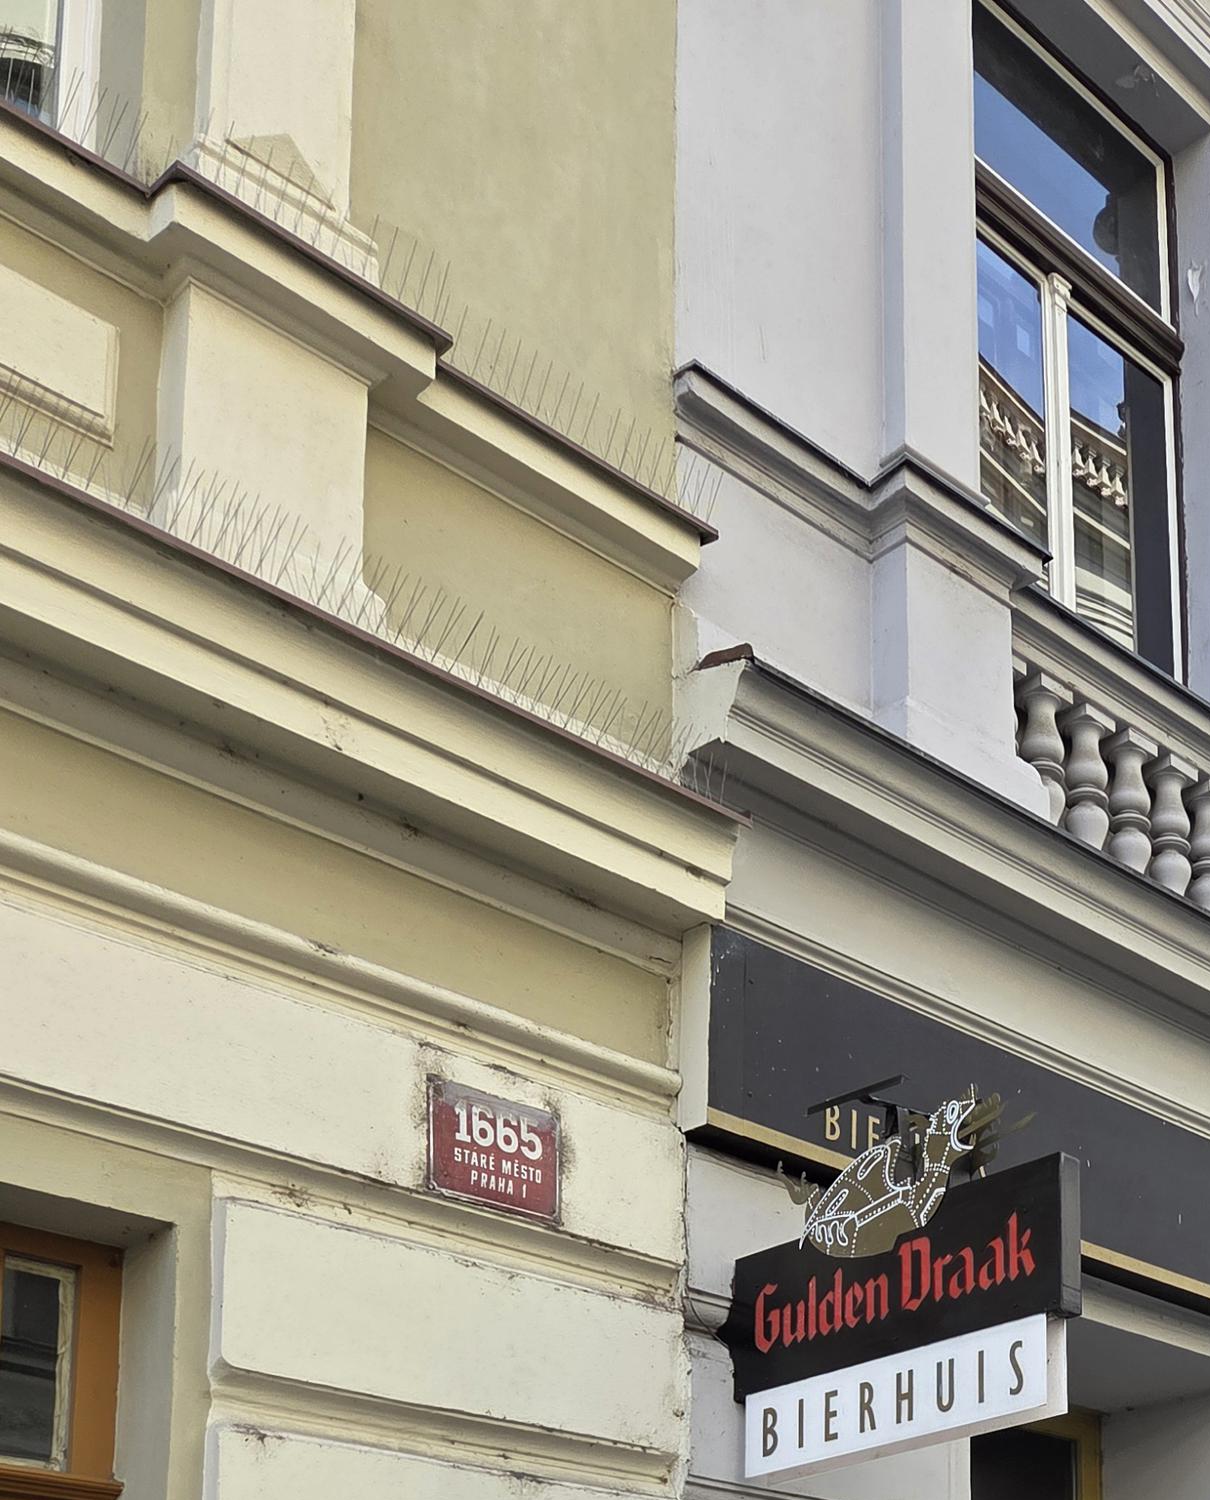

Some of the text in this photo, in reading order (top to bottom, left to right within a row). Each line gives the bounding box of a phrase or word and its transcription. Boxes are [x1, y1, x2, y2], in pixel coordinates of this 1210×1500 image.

[453, 1100, 543, 1160] 1665
[454, 1147, 542, 1184] STARÉ MĚSTO
[470, 1170, 528, 1198] PRAHA 1
[754, 1211, 1036, 1354] Gulden Draak
[762, 1340, 1024, 1457] BIERHUIS
